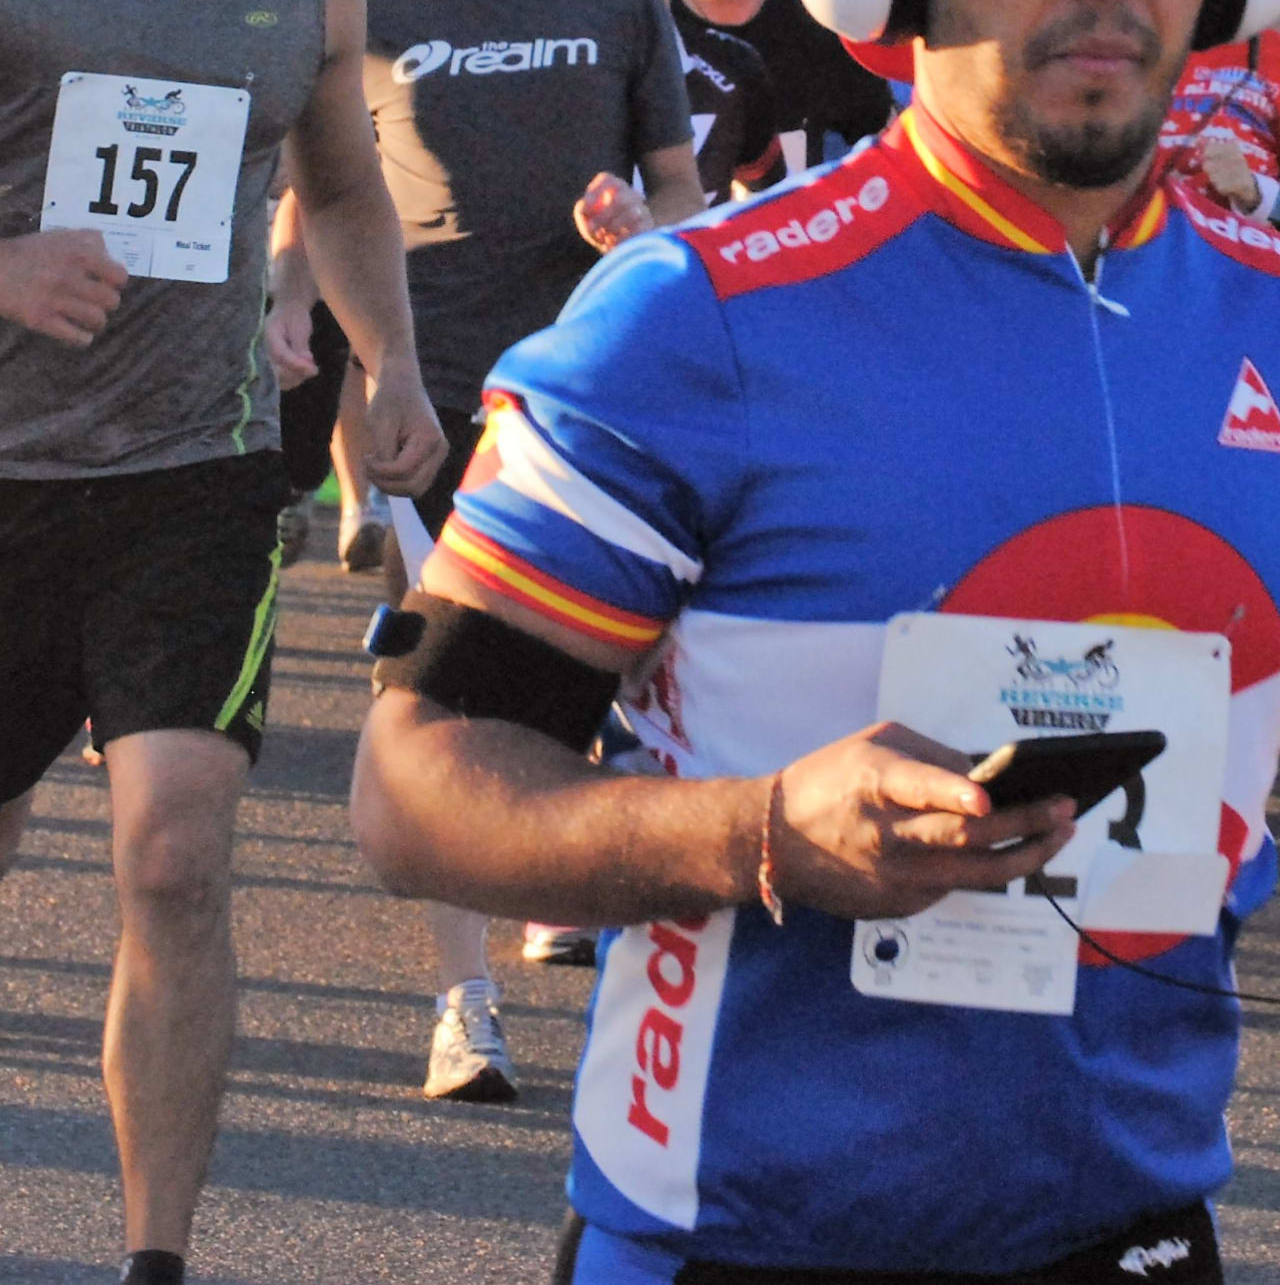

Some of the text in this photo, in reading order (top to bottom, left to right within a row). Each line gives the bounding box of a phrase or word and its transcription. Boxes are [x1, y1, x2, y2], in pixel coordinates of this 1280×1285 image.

[449, 37, 598, 77] realm
[88, 143, 198, 222] 157
[719, 176, 889, 264] radere
